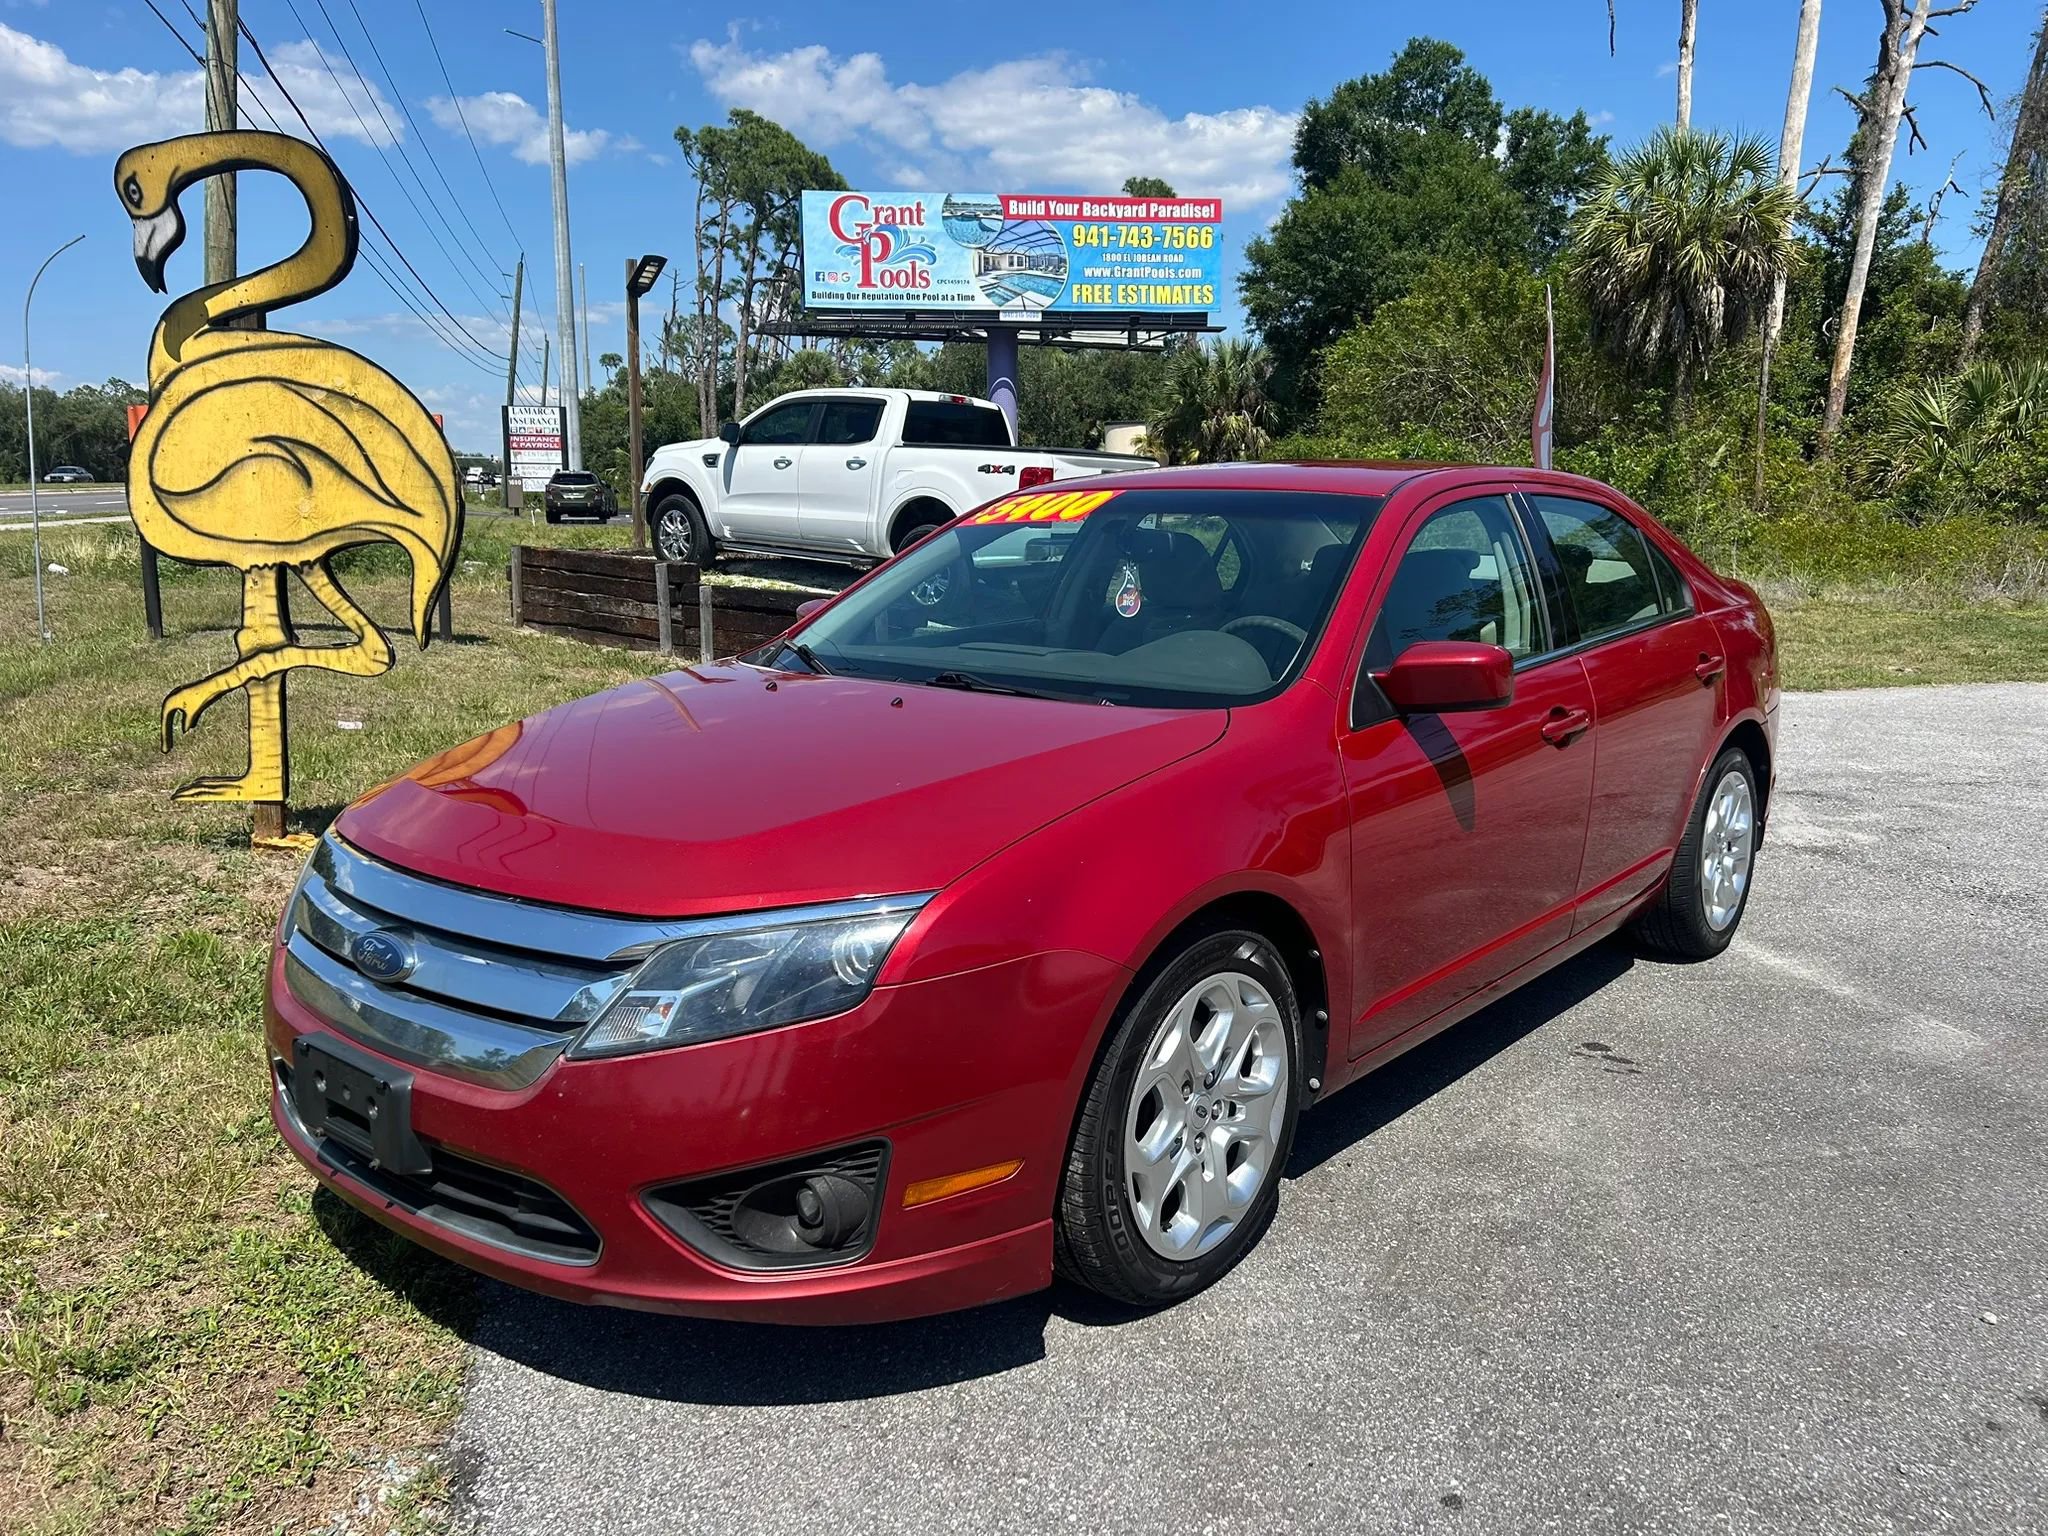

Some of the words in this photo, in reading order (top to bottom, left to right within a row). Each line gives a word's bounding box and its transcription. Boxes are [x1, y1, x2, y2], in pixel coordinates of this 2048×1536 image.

[1009, 200, 1046, 216] Build
[1049, 201, 1080, 216] Your
[1082, 202, 1147, 219] Backyard
[1150, 203, 1216, 219] Paradise!
[829, 194, 926, 244] Grant
[1072, 223, 1214, 249] 941-743-7566
[857, 223, 931, 289] Pools
[1102, 254, 1121, 263] 1800
[1123, 254, 1132, 263] EL
[1132, 254, 1162, 263] JOBEAN
[1163, 254, 1184, 263] ROAD
[1084, 266, 1202, 279] www.GrantPools.com
[811, 291, 845, 301] Building
[846, 292, 860, 301] Our
[861, 292, 905, 302] Reputation
[906, 292, 921, 301] One
[922, 293, 940, 301] Pool
[940, 293, 949, 302] at
[956, 293, 976, 302] Time
[1072, 284, 1113, 304] FREE
[1116, 285, 1215, 305] ESTIMATES
[512, 407, 556, 416] LAMARCA
[509, 417, 559, 425] INSURANCE
[510, 435, 560, 443] INSURANCE
